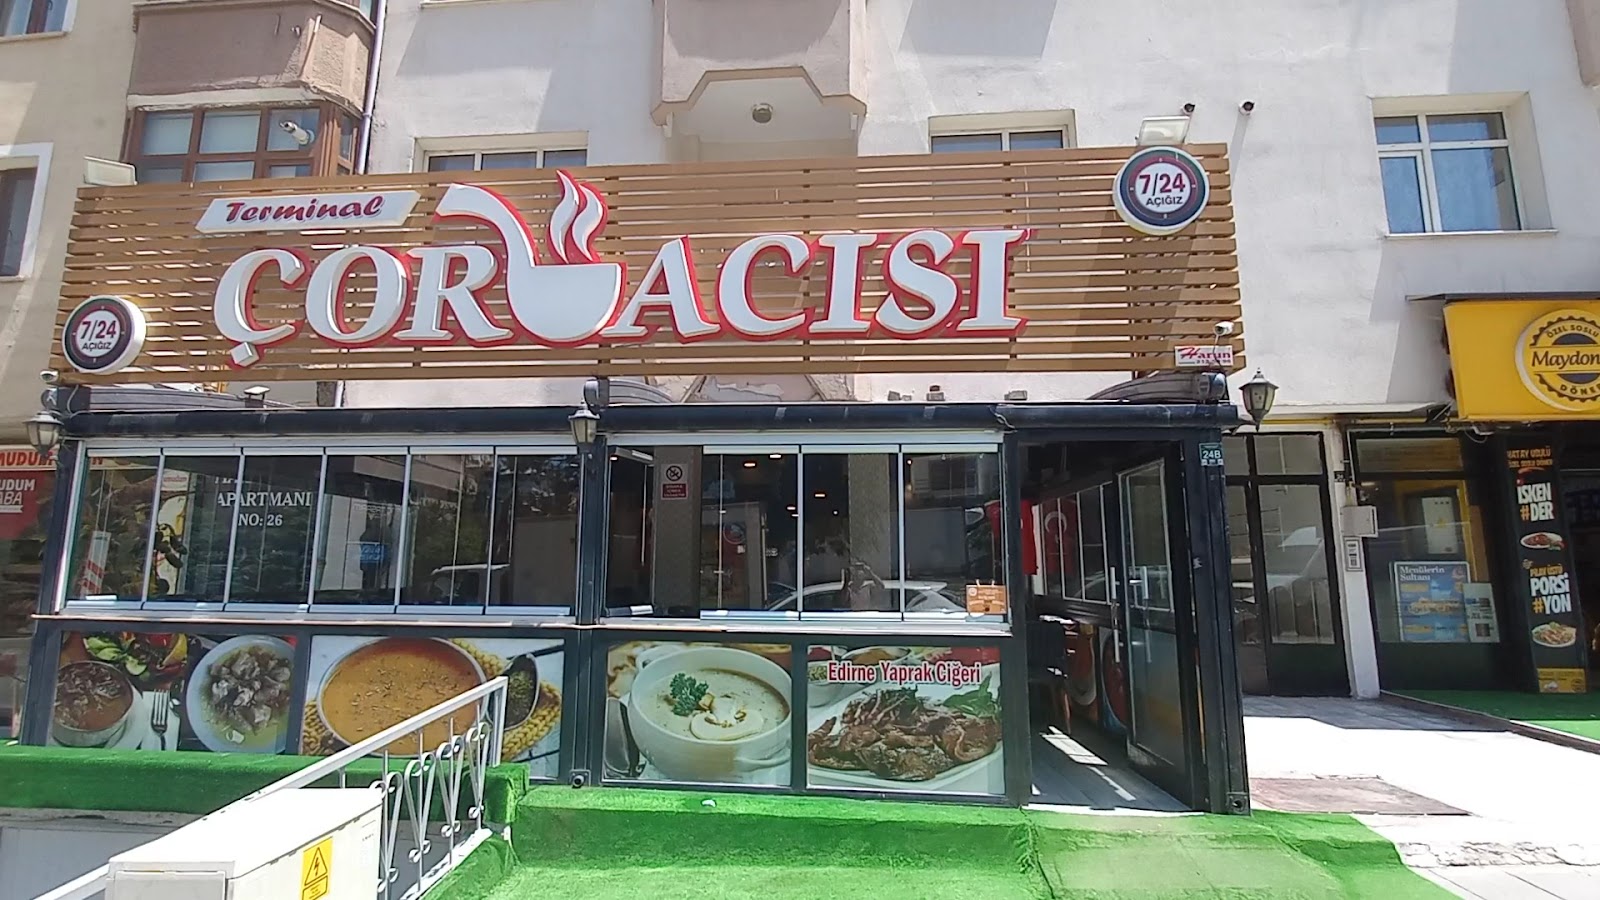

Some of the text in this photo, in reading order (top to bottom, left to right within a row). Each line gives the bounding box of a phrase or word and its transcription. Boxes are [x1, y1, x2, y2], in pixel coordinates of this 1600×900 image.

[1139, 173, 1186, 196] 7/24
[226, 195, 384, 223] Terminal
[1146, 195, 1183, 208] AÇIĞIZ
[80, 320, 117, 341] 7/24
[1546, 324, 1599, 338] ÖZEL SOSLU
[82, 341, 112, 351] AÇIĞIZ
[1177, 346, 1231, 359] Harun
[1531, 350, 1600, 370] Maydon
[1202, 450, 1221, 459] 24B
[217, 491, 312, 507] APARTMANI
[238, 513, 283, 526] NO: 26
[1520, 501, 1555, 522] #DER
[1400, 566, 1445, 574] Menülerin
[1532, 593, 1572, 615] #YON
[828, 661, 982, 688] Edirne Yaprak Ciğeri
